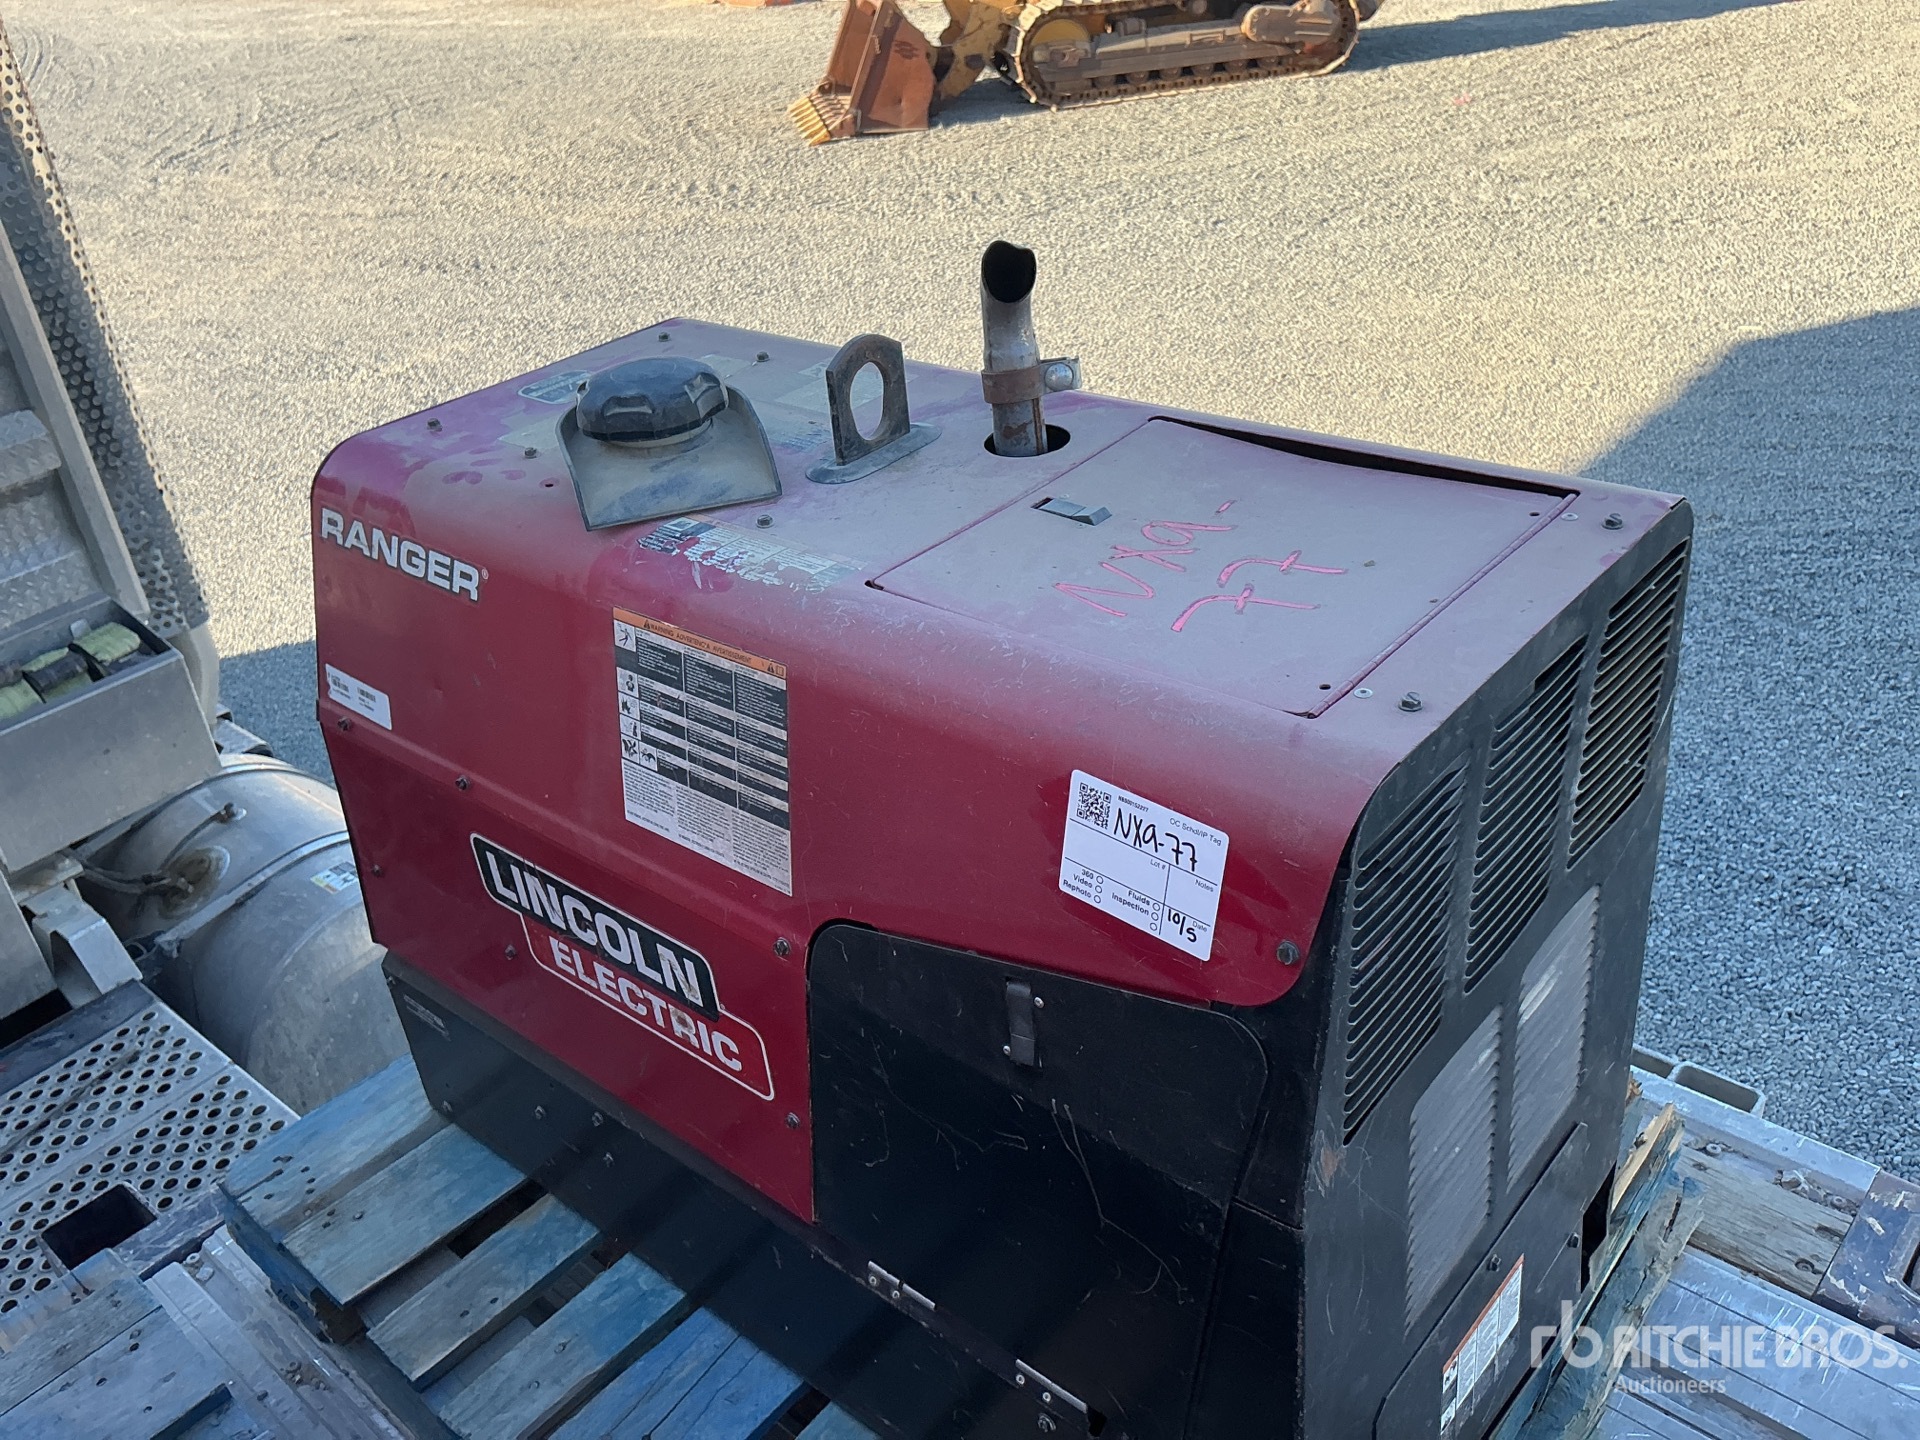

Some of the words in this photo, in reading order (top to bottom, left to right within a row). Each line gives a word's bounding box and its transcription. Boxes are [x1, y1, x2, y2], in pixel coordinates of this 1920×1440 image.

[1170, 550, 1349, 633] 77
[649, 623, 675, 638] WARNING
[1209, 834, 1222, 846] Tag
[1150, 859, 1161, 868] Lot
[1073, 874, 1093, 889] Video
[1081, 869, 1094, 880] 360
[1063, 880, 1092, 899] Rephoto
[1195, 879, 1214, 892] Notes
[1112, 892, 1149, 916] Inspection
[1127, 890, 1151, 906] Fluids
[485, 850, 704, 1008] LINCOLN
[1167, 909, 1198, 943] 10/5
[1192, 920, 1208, 932] Date
[548, 936, 743, 1073] ELECTRIC
